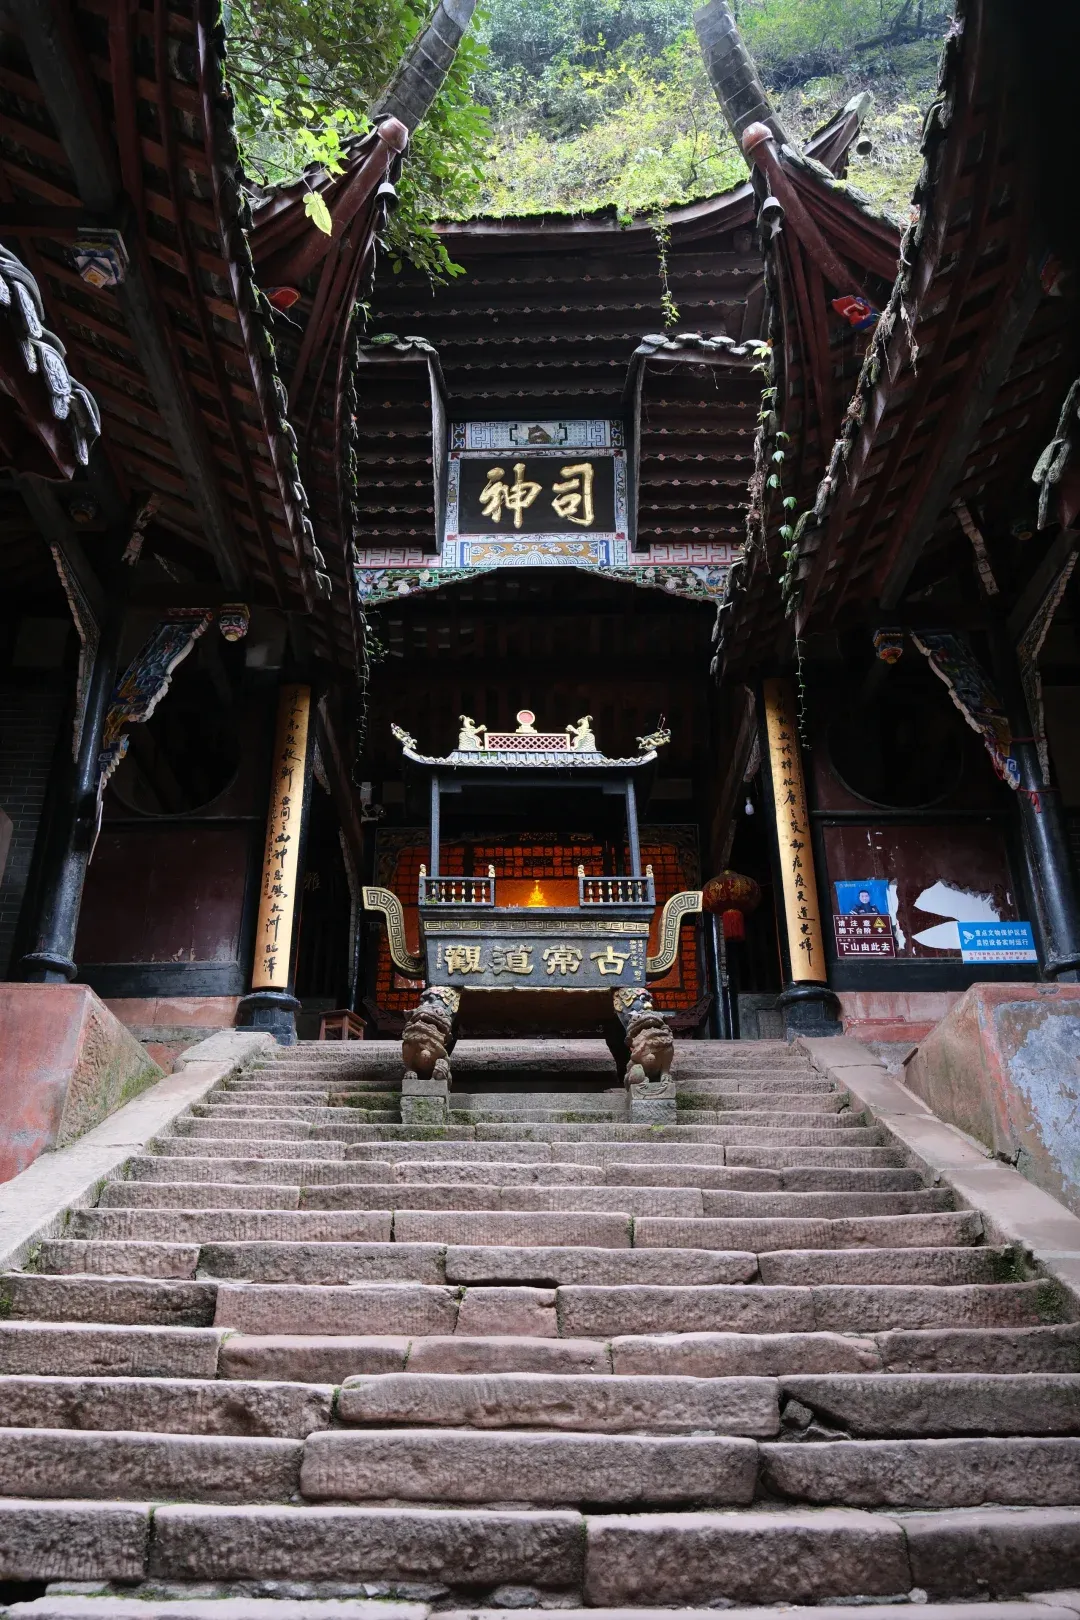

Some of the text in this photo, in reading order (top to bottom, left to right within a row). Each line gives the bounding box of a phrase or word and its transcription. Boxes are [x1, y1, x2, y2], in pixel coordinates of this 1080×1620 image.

[838, 927, 872, 935] 脚下台阶
[975, 928, 1028, 937] 重点文物保护区域
[839, 942, 891, 952] 下山由此去
[976, 938, 1029, 947] 监控设备实时运行
